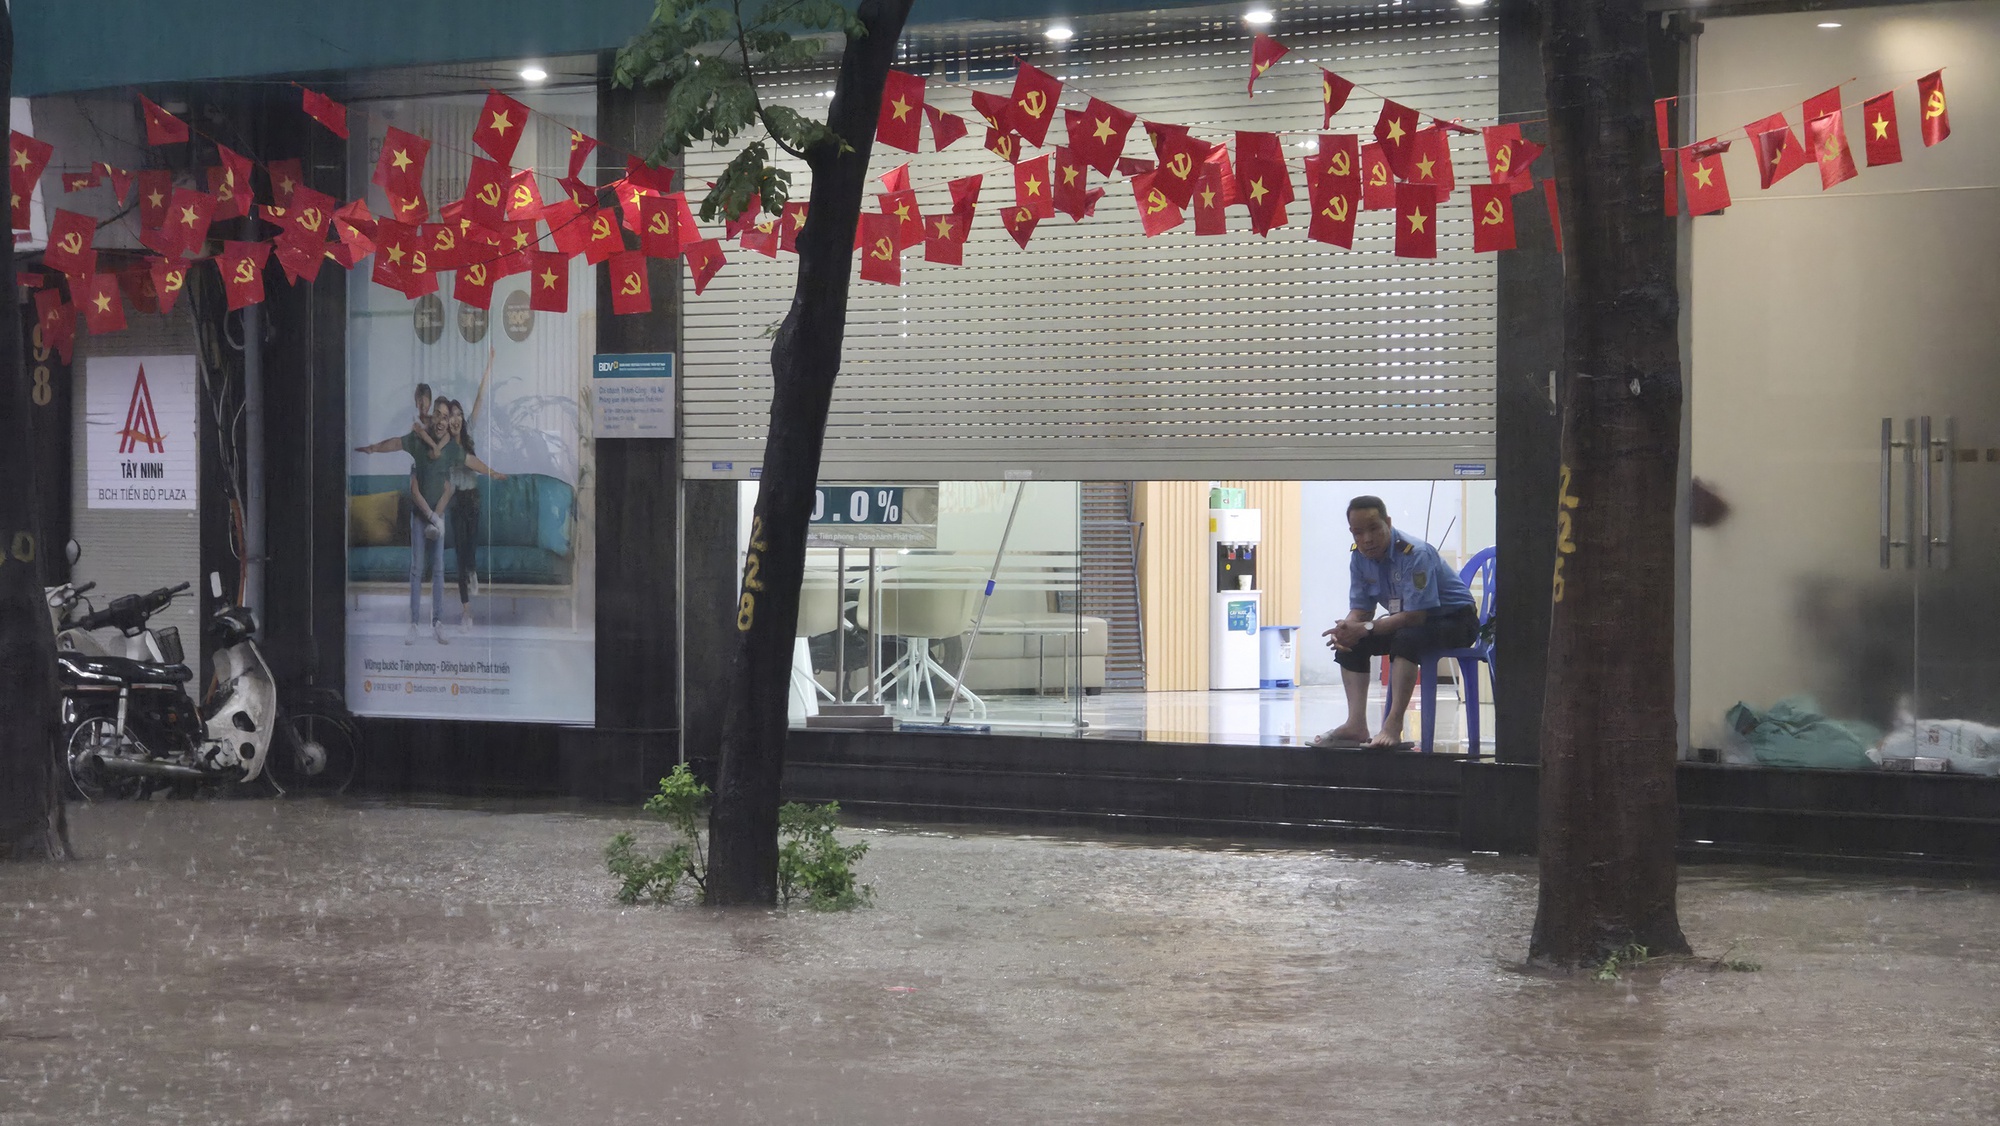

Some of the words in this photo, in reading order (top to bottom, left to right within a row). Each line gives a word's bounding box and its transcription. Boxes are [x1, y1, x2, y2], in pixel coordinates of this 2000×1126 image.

[598, 362, 614, 372] BIDV
[121, 461, 138, 479] TÂY
[140, 462, 164, 479] NINH
[98, 488, 118, 501] BCH
[120, 485, 141, 501] TIẾN
[158, 489, 187, 501] PLAZA
[737, 515, 768, 632] 228
[415, 661, 436, 674] phong
